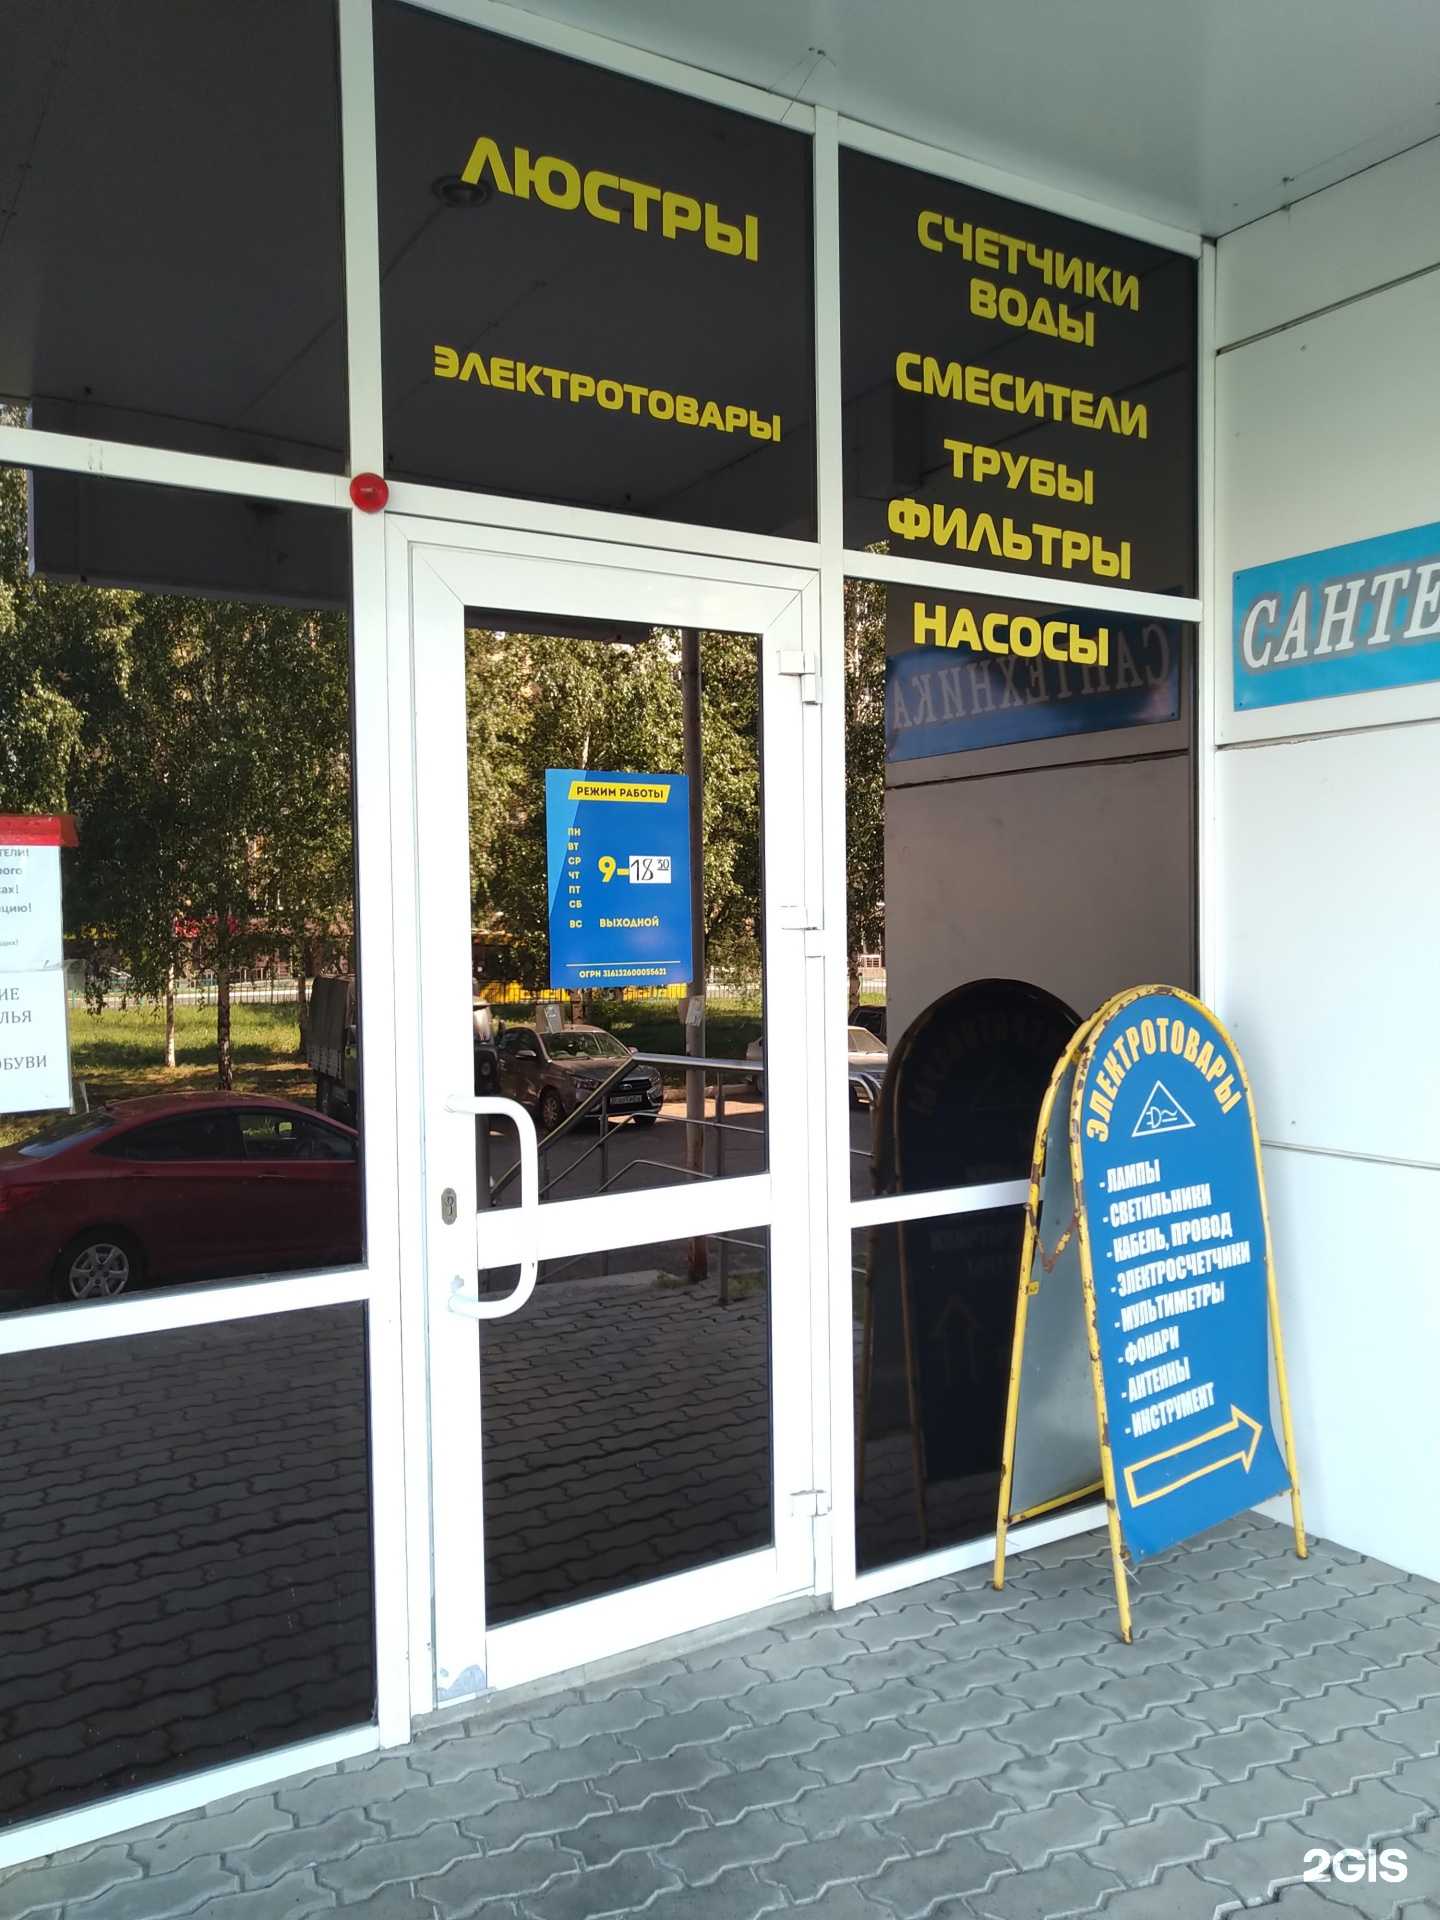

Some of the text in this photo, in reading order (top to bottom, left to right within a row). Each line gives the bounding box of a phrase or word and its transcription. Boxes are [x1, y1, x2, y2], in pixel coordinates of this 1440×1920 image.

[461, 137, 758, 262] ЛЮСТРЫ
[917, 211, 1140, 311] СЧЕТЧИКИ
[969, 278, 1095, 347] ВОДЫ
[434, 344, 781, 442] ЭЛЕКТРОТОВАРЫ
[896, 351, 1147, 439] СМЕСИТЕЛИ
[944, 438, 1093, 505] ТРУБЫ
[888, 497, 1131, 580] ФИЛЬТРЫ
[914, 602, 1109, 666] НАСОСЫ
[576, 786, 664, 798] РЕЖИМ РАБОТЫ
[567, 827, 581, 836] ПН
[567, 842, 579, 850] ВТ
[568, 856, 581, 865] СР
[568, 871, 580, 879] ЧТ
[568, 885, 581, 894] ПТ
[569, 900, 582, 908] СБ
[569, 915, 660, 928] ВС ВЫХОДНОЙ
[579, 970, 601, 978] ОГРН
[0, 1055, 47, 1071] БУВИ
[1086, 1017, 1242, 1142] ЭЛЕКТРОТОВАРЫ
[1170, 1212, 1233, 1247] ПРОВОД
